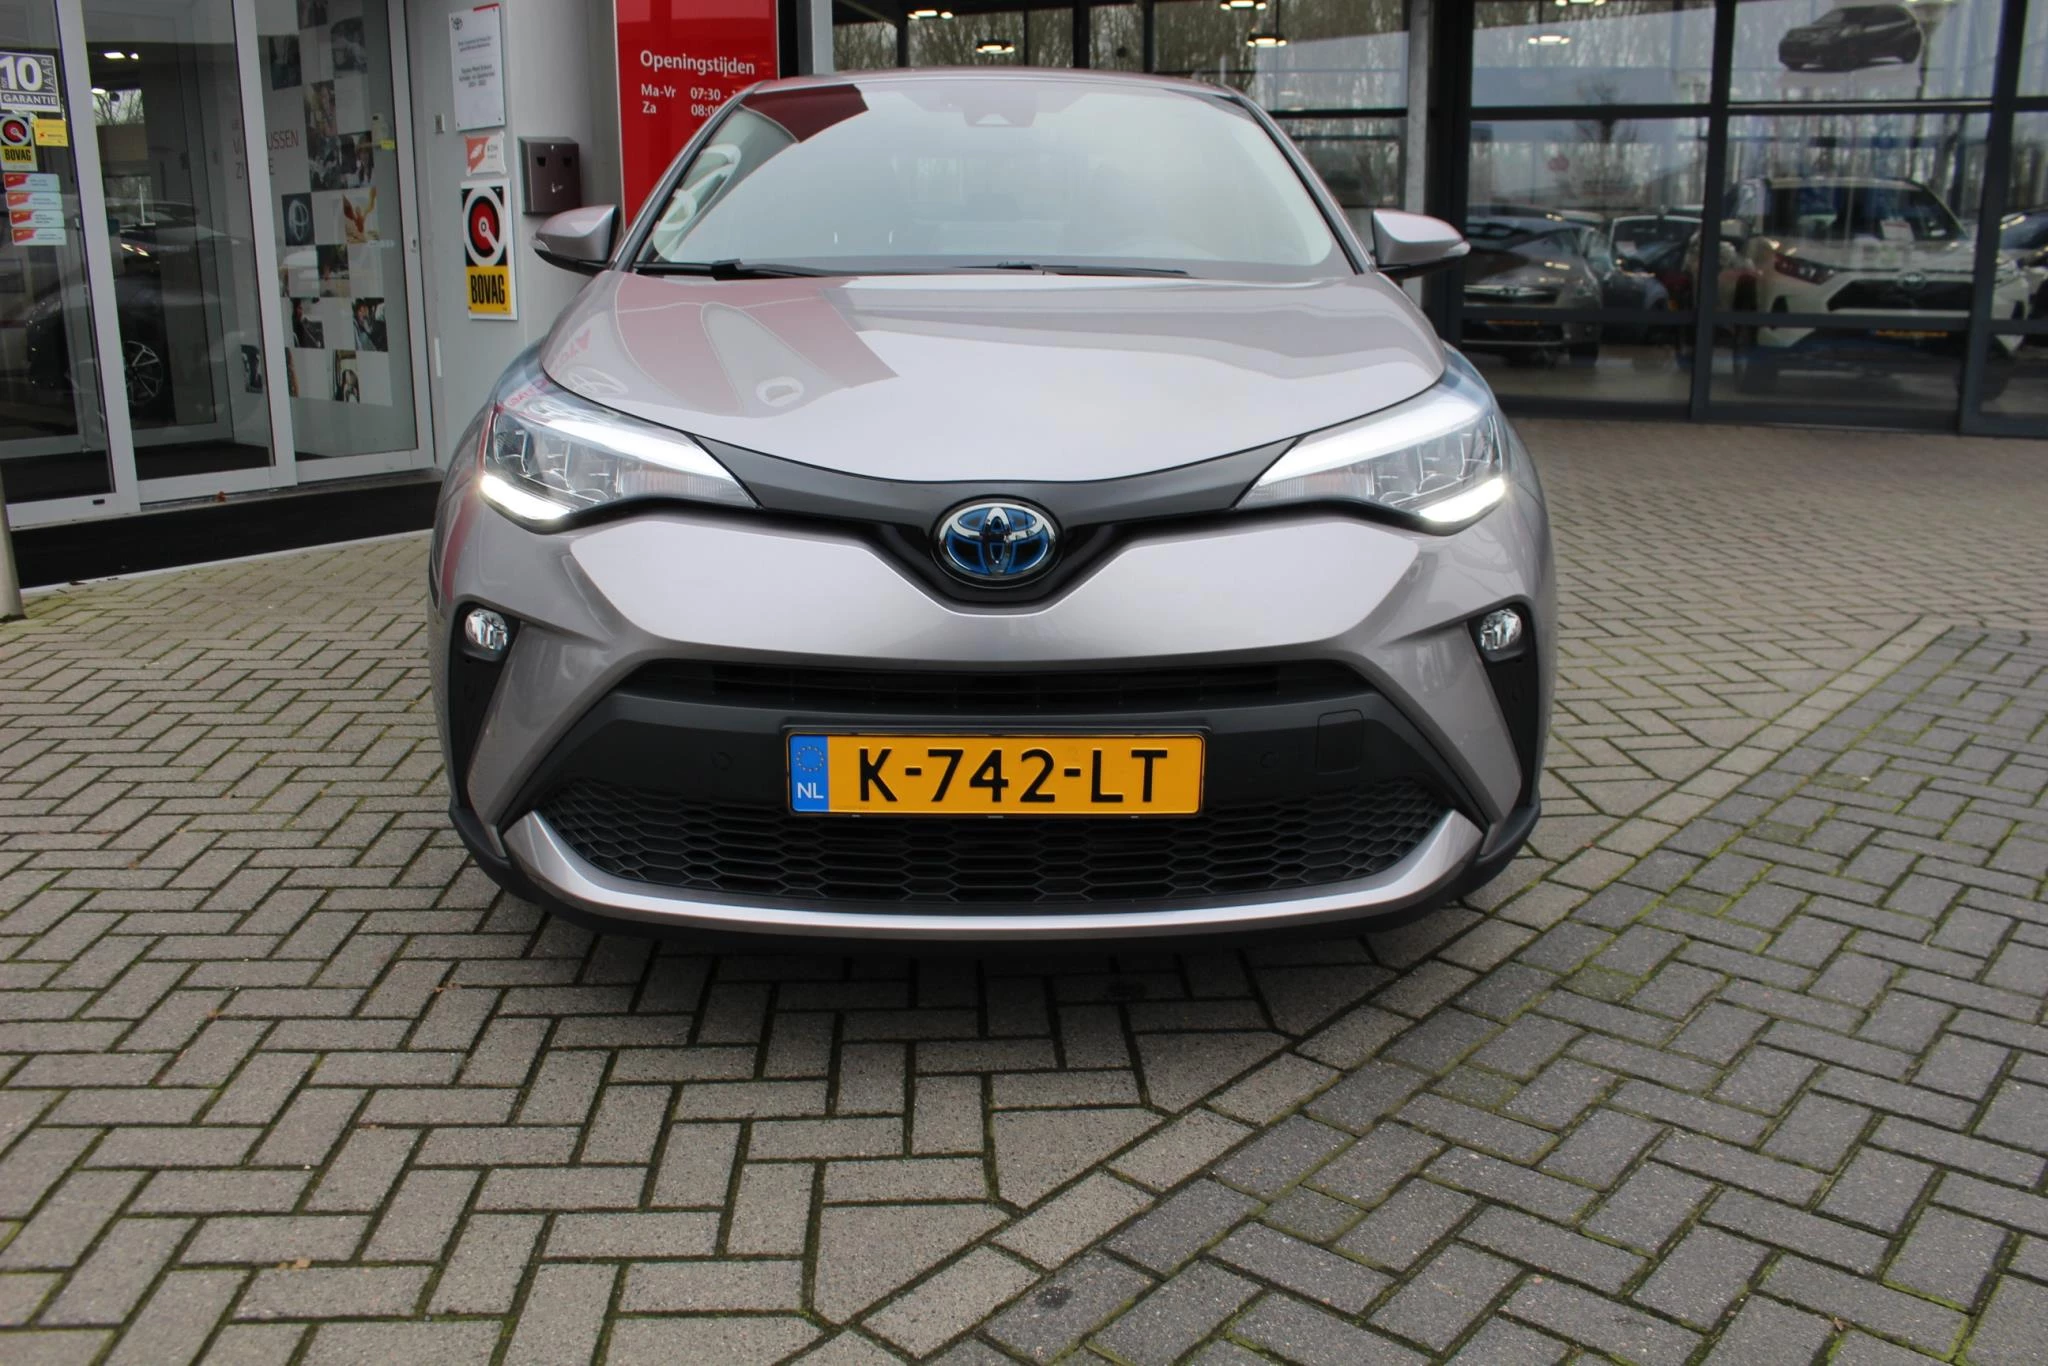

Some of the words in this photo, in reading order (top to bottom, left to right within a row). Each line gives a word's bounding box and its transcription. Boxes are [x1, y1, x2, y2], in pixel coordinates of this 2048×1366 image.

[0, 55, 43, 91] 10
[640, 50, 755, 77] Openingstijden
[40, 58, 56, 93] JAAR
[3, 93, 57, 105] GARANTIE
[641, 83, 676, 98] Ma-Vr
[690, 87, 721, 101] 07:30
[642, 101, 657, 114] Za
[4, 148, 32, 161] BOVAG
[470, 274, 506, 305] BOVAG
[858, 748, 1168, 803] K-742-LT
[797, 782, 824, 799] NL
